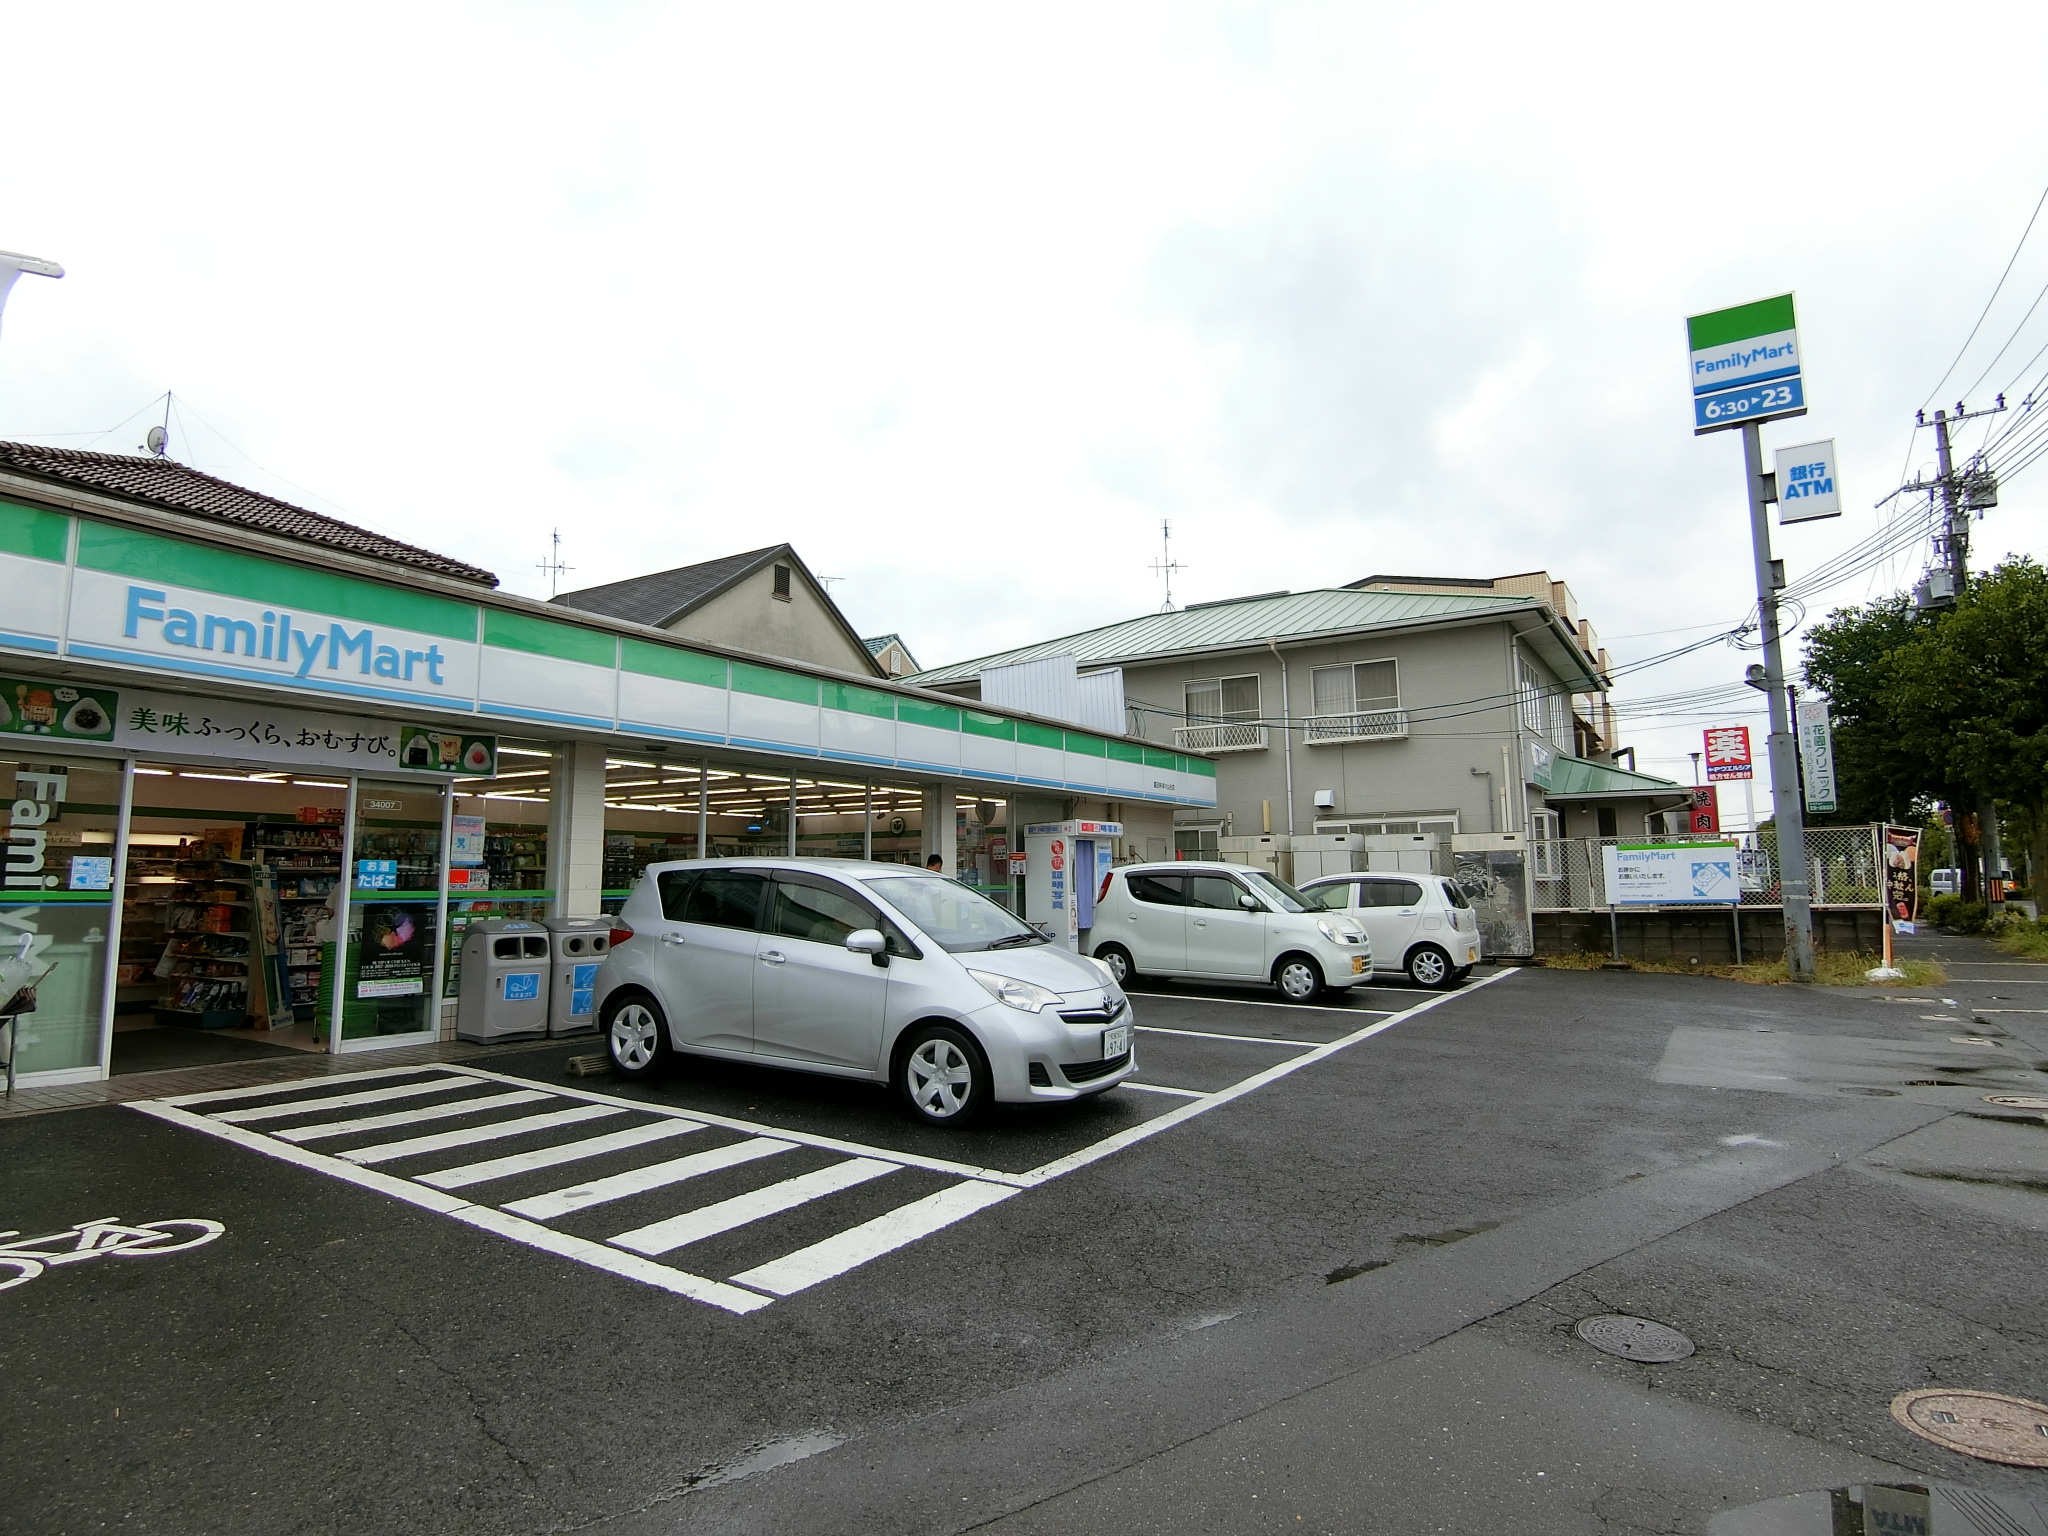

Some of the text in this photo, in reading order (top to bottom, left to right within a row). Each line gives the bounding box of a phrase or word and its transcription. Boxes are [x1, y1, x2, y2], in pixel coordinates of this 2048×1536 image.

[1695, 342, 1794, 375] FamilyMart
[1705, 386, 1792, 418] 6:30 23
[1789, 462, 1827, 481] 銀行
[1785, 478, 1833, 501] ATM
[123, 585, 444, 685] FamilyMart
[1707, 730, 1747, 763] 薬
[1812, 724, 1830, 799] 花園クリニック
[370, 800, 396, 809] 34007
[366, 861, 390, 872] お酒
[1617, 852, 1676, 862] FamilyMart
[358, 874, 396, 887] たばこ
[1052, 871, 1064, 909] 証明写真
